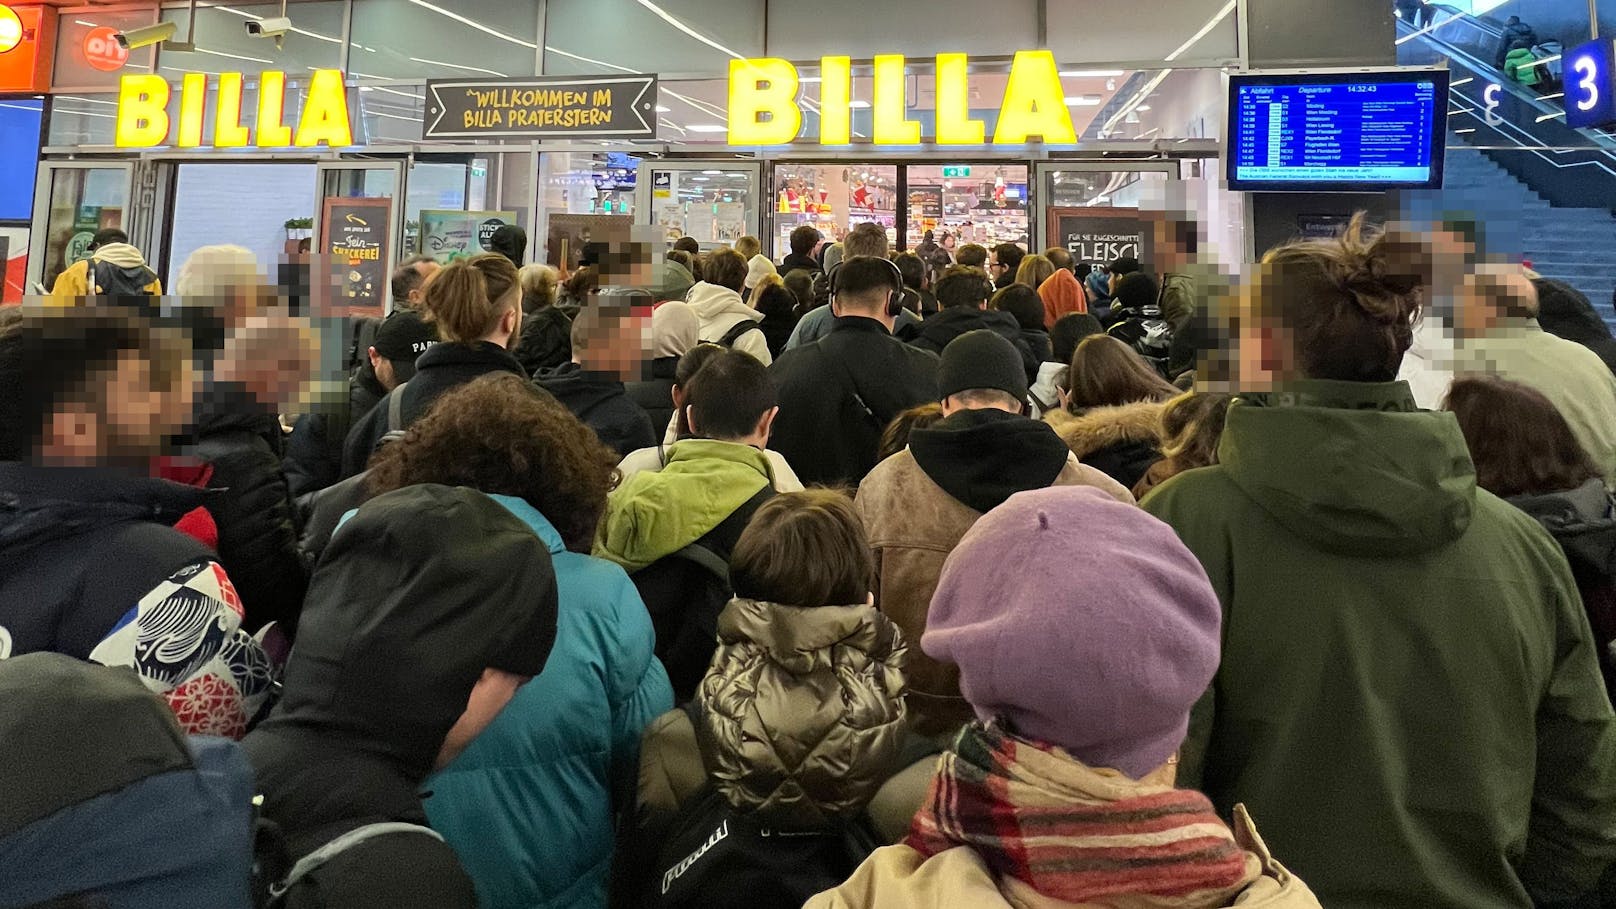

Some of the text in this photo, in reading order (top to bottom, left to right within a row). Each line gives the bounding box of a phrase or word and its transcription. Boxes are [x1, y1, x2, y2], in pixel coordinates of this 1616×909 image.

[1298, 86, 1332, 94] Departure
[1574, 56, 1599, 111] 3
[467, 88, 612, 108] WILLKOMMEN IM
[728, 50, 1077, 145] BILLA
[116, 69, 353, 148] BILLA
[463, 108, 613, 128] BILLA PRATERSTERN
[345, 234, 367, 248] Fein
